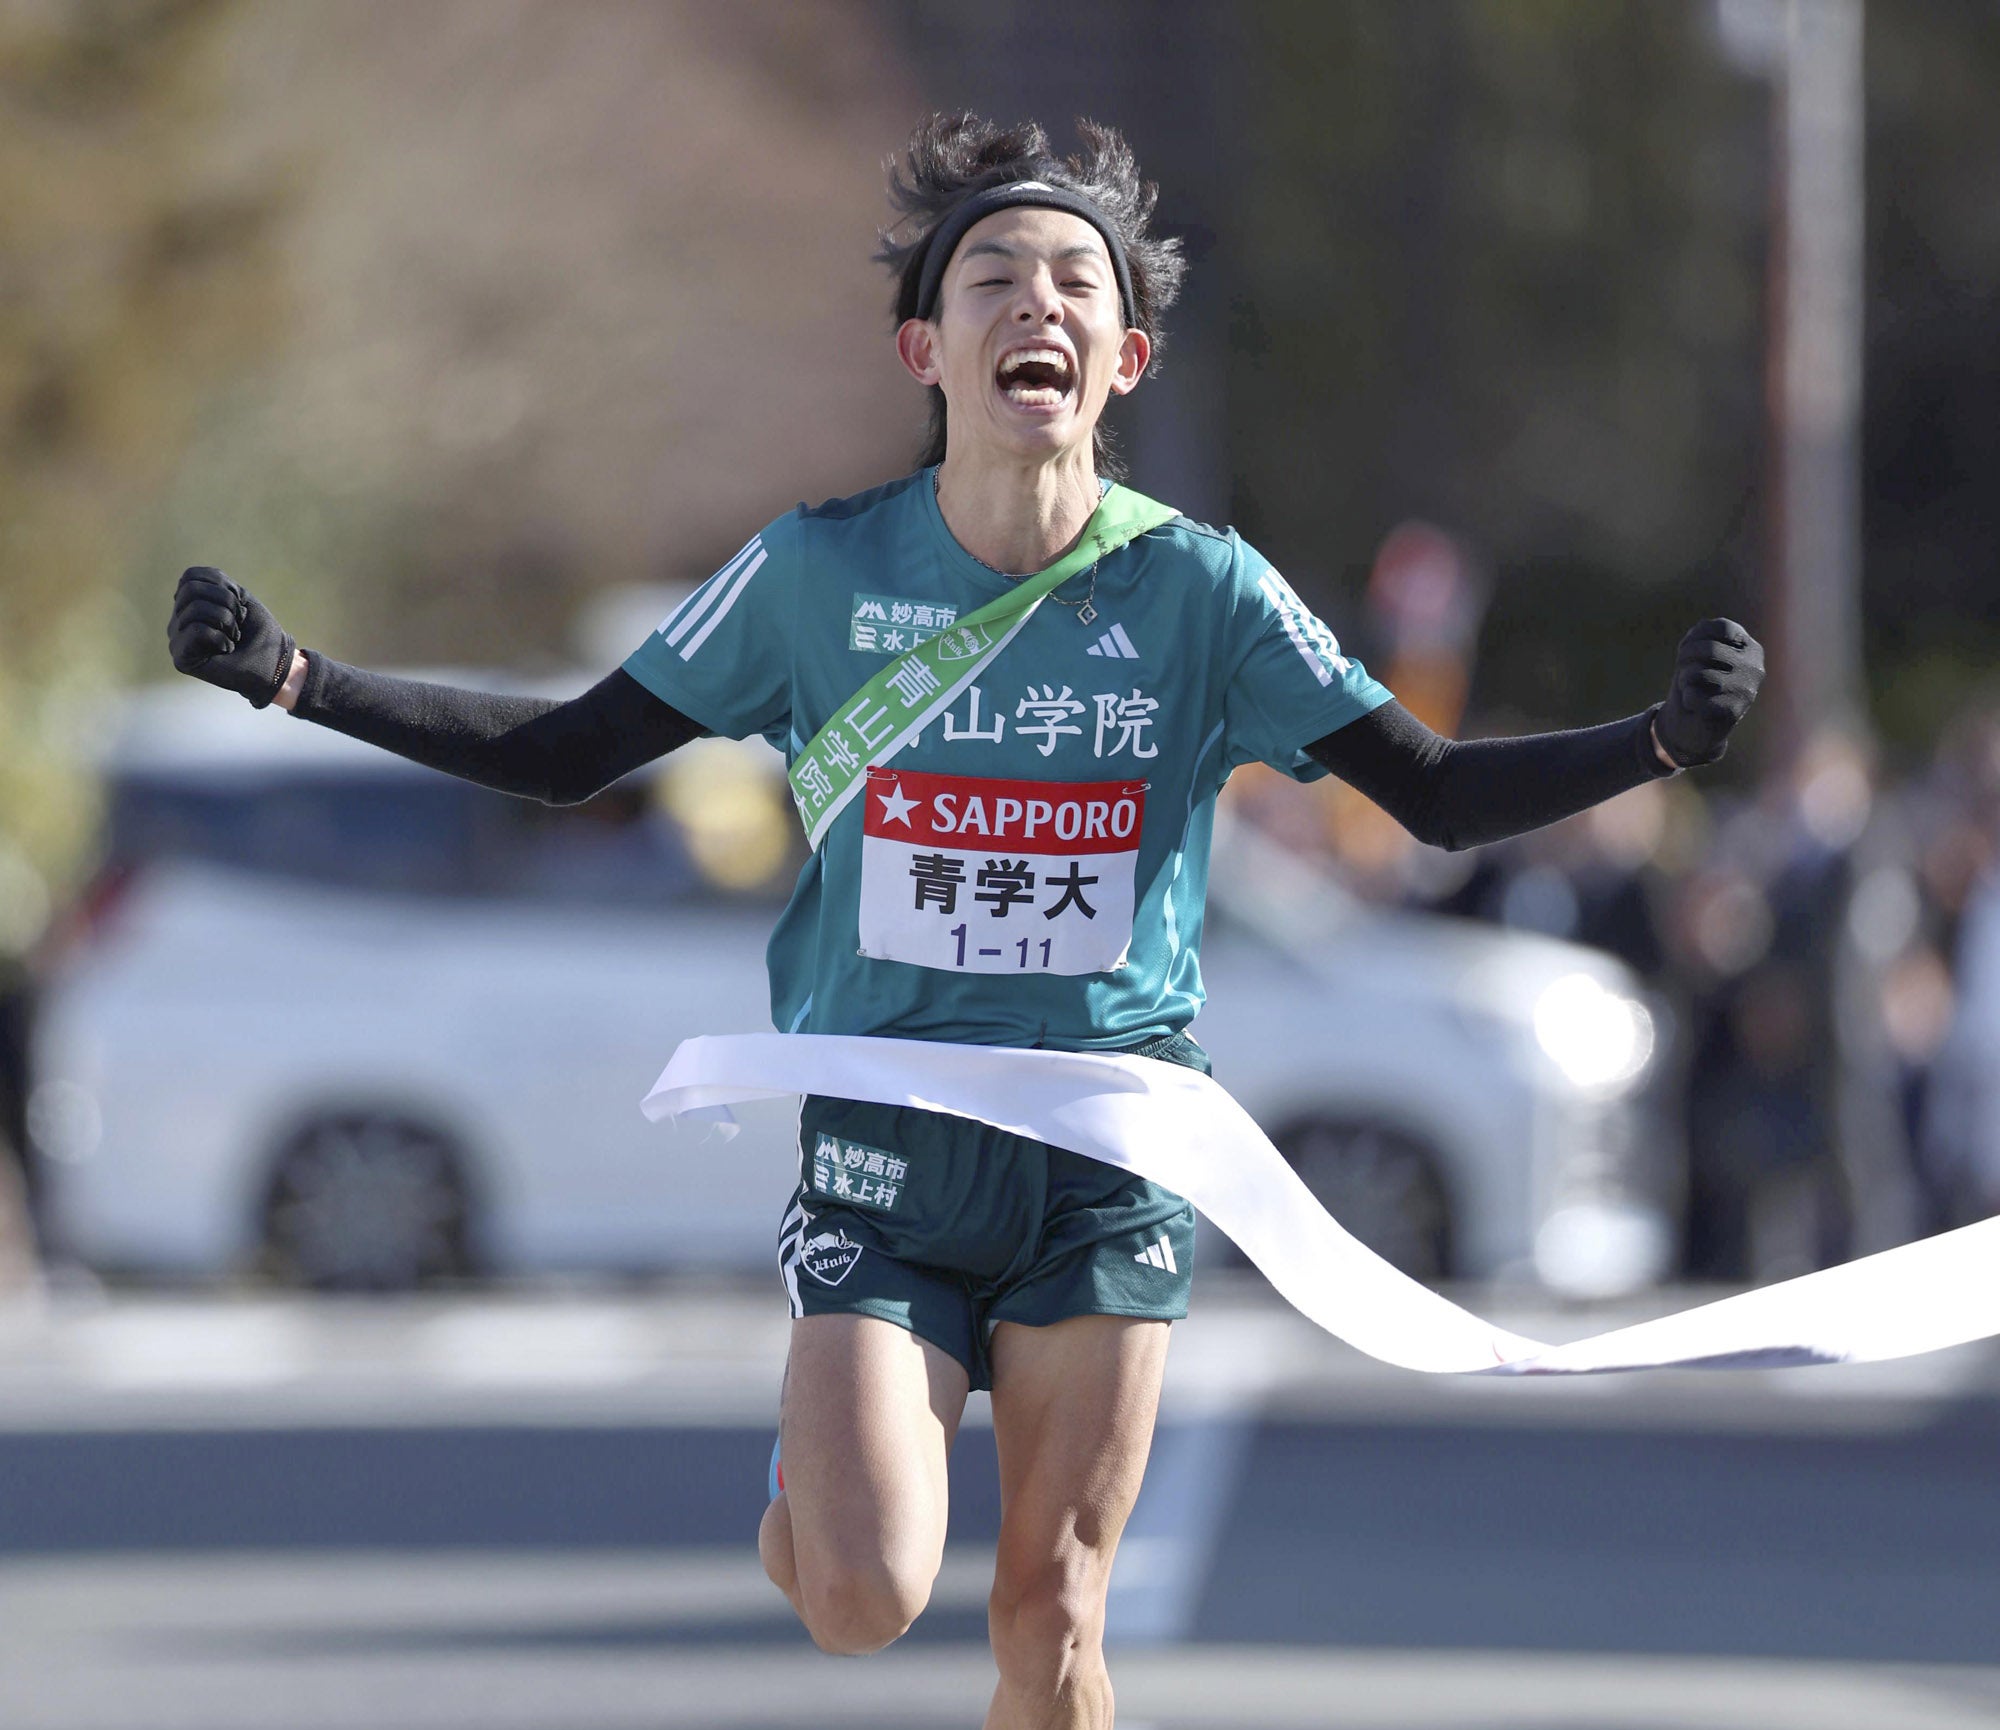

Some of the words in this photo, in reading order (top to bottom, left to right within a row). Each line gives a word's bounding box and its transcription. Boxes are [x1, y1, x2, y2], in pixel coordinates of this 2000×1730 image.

[890, 602, 957, 629] 妙高市
[882, 629, 937, 651] 水上
[908, 684, 1160, 758] 山学院
[931, 792, 1137, 841] SAPPORO
[909, 853, 1099, 920] 青学大
[844, 1145, 908, 1180] 妙高市
[833, 1173, 897, 1208] 水上村
